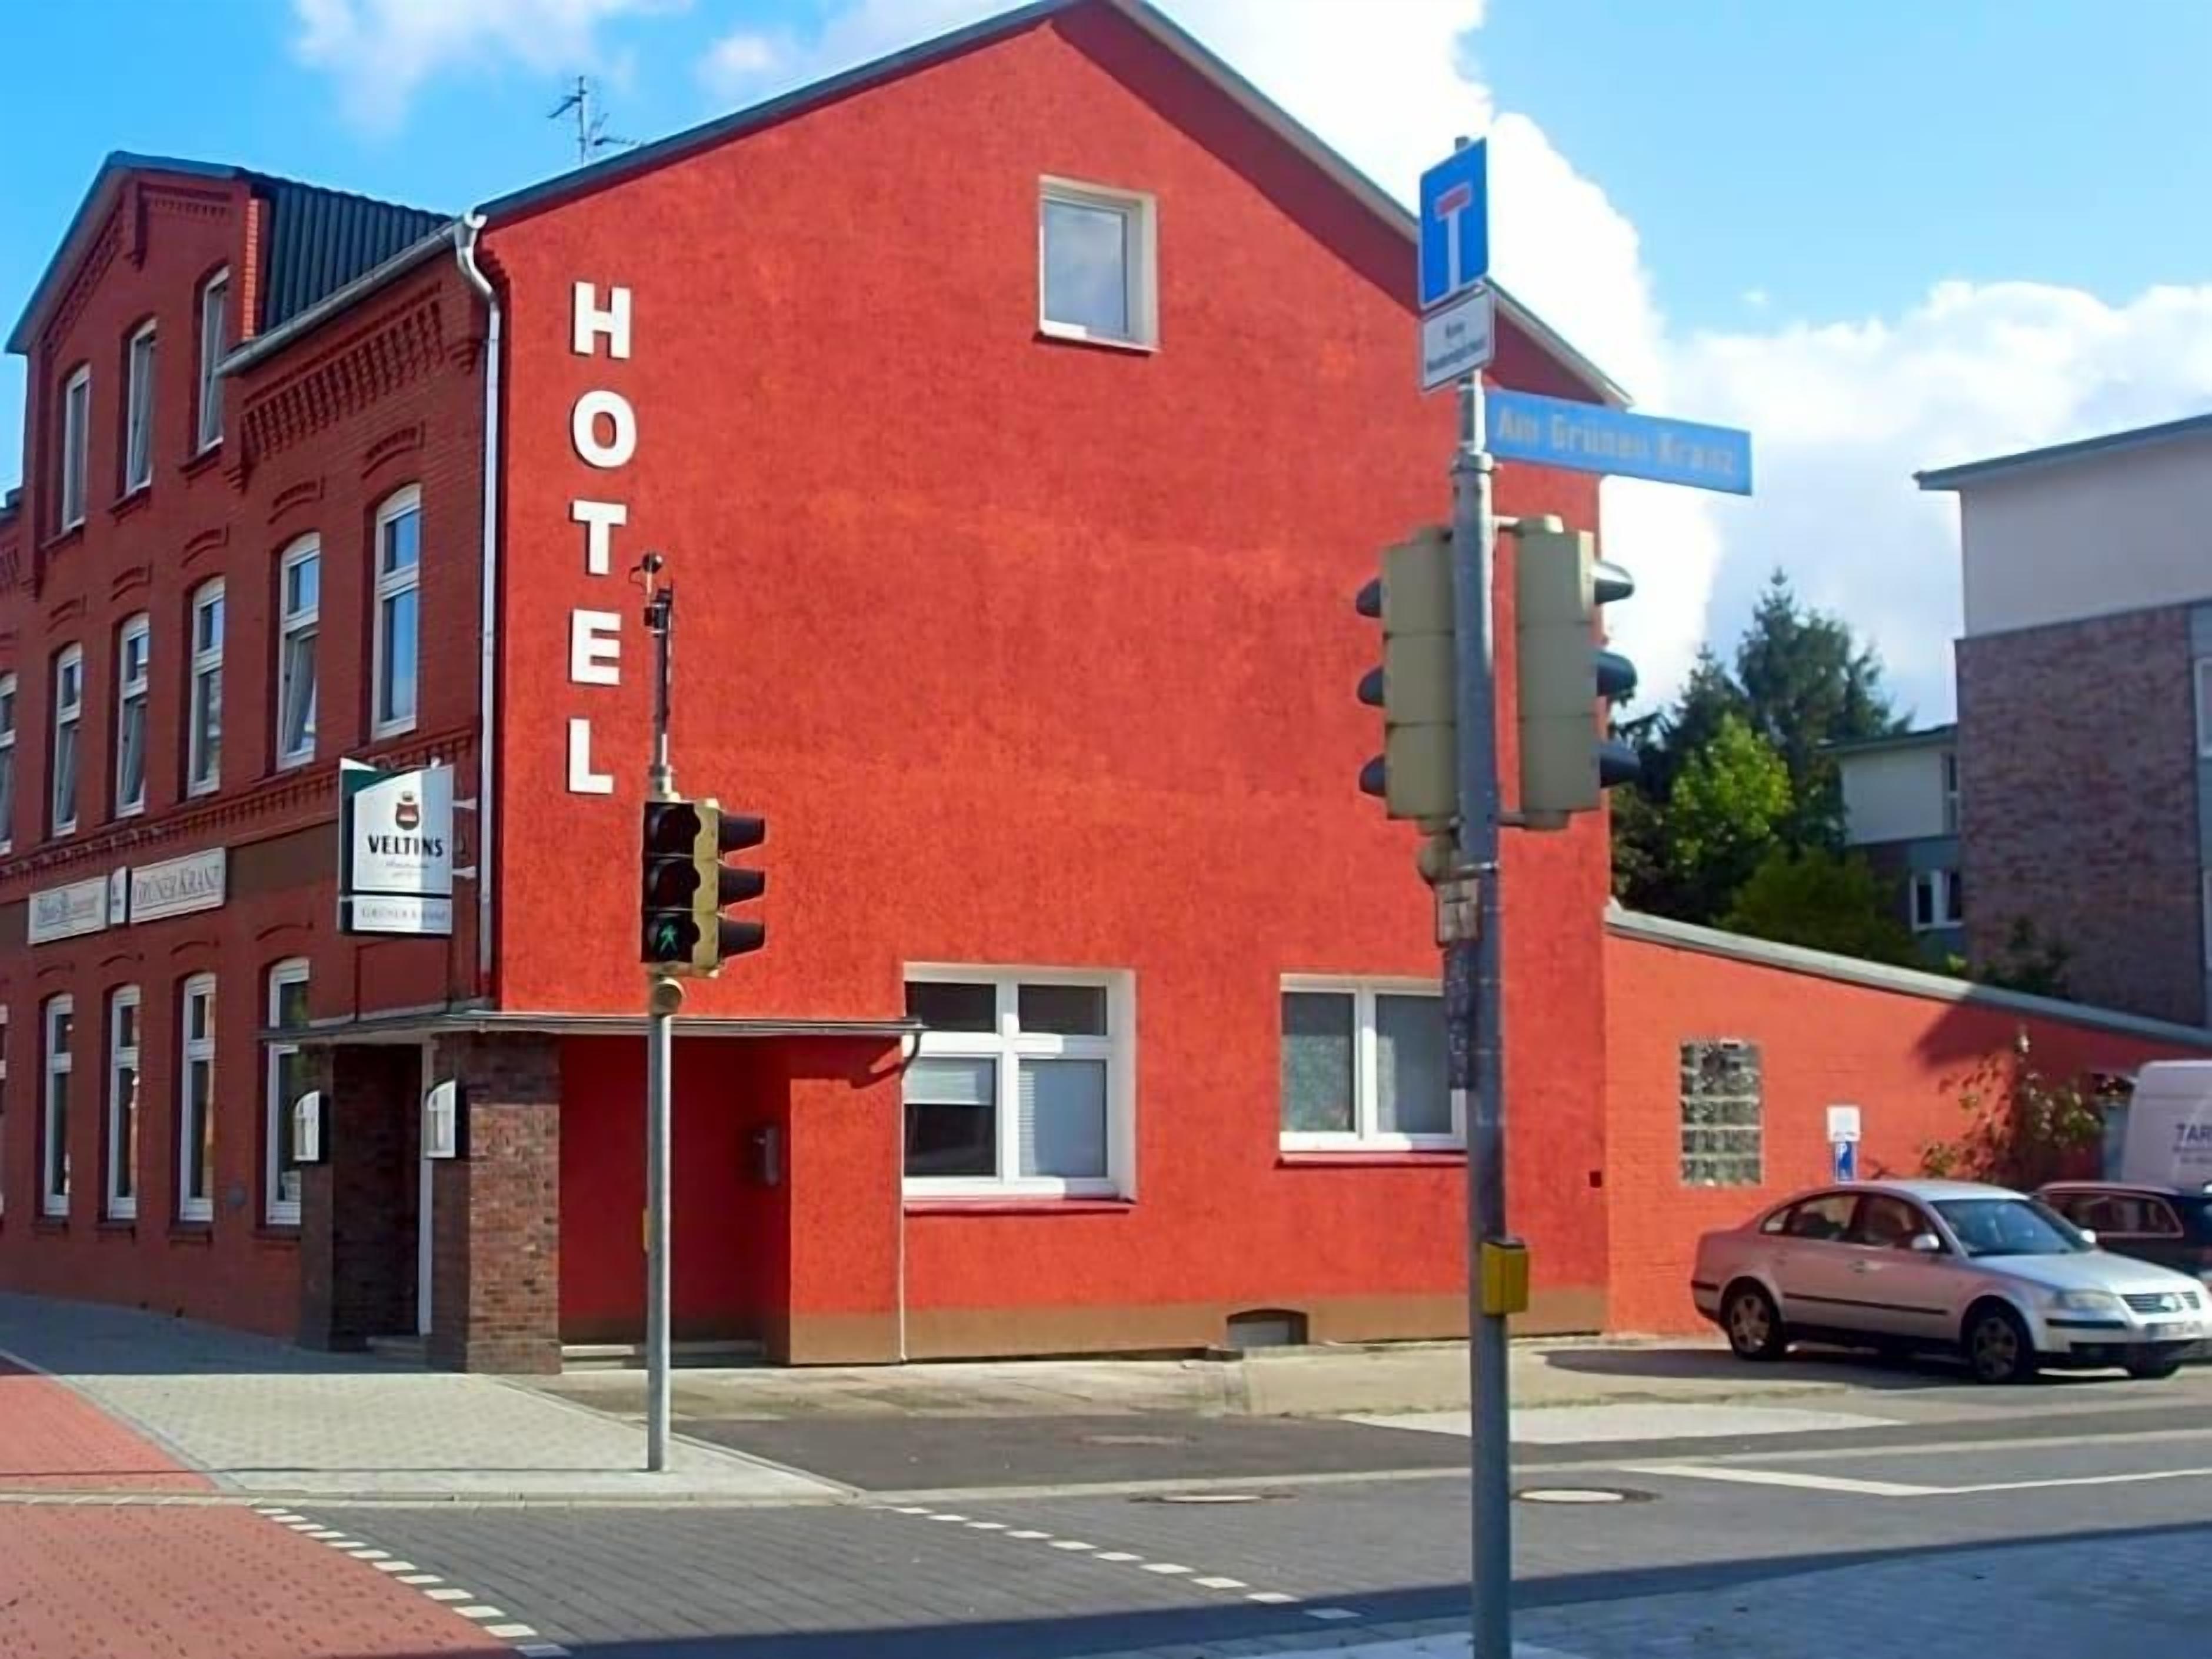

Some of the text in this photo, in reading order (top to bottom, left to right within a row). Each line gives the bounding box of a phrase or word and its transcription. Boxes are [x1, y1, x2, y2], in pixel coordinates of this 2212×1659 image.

[1499, 408, 1540, 444] Am
[569, 281, 636, 794] HOTEL
[368, 834, 443, 857] VELTINS
